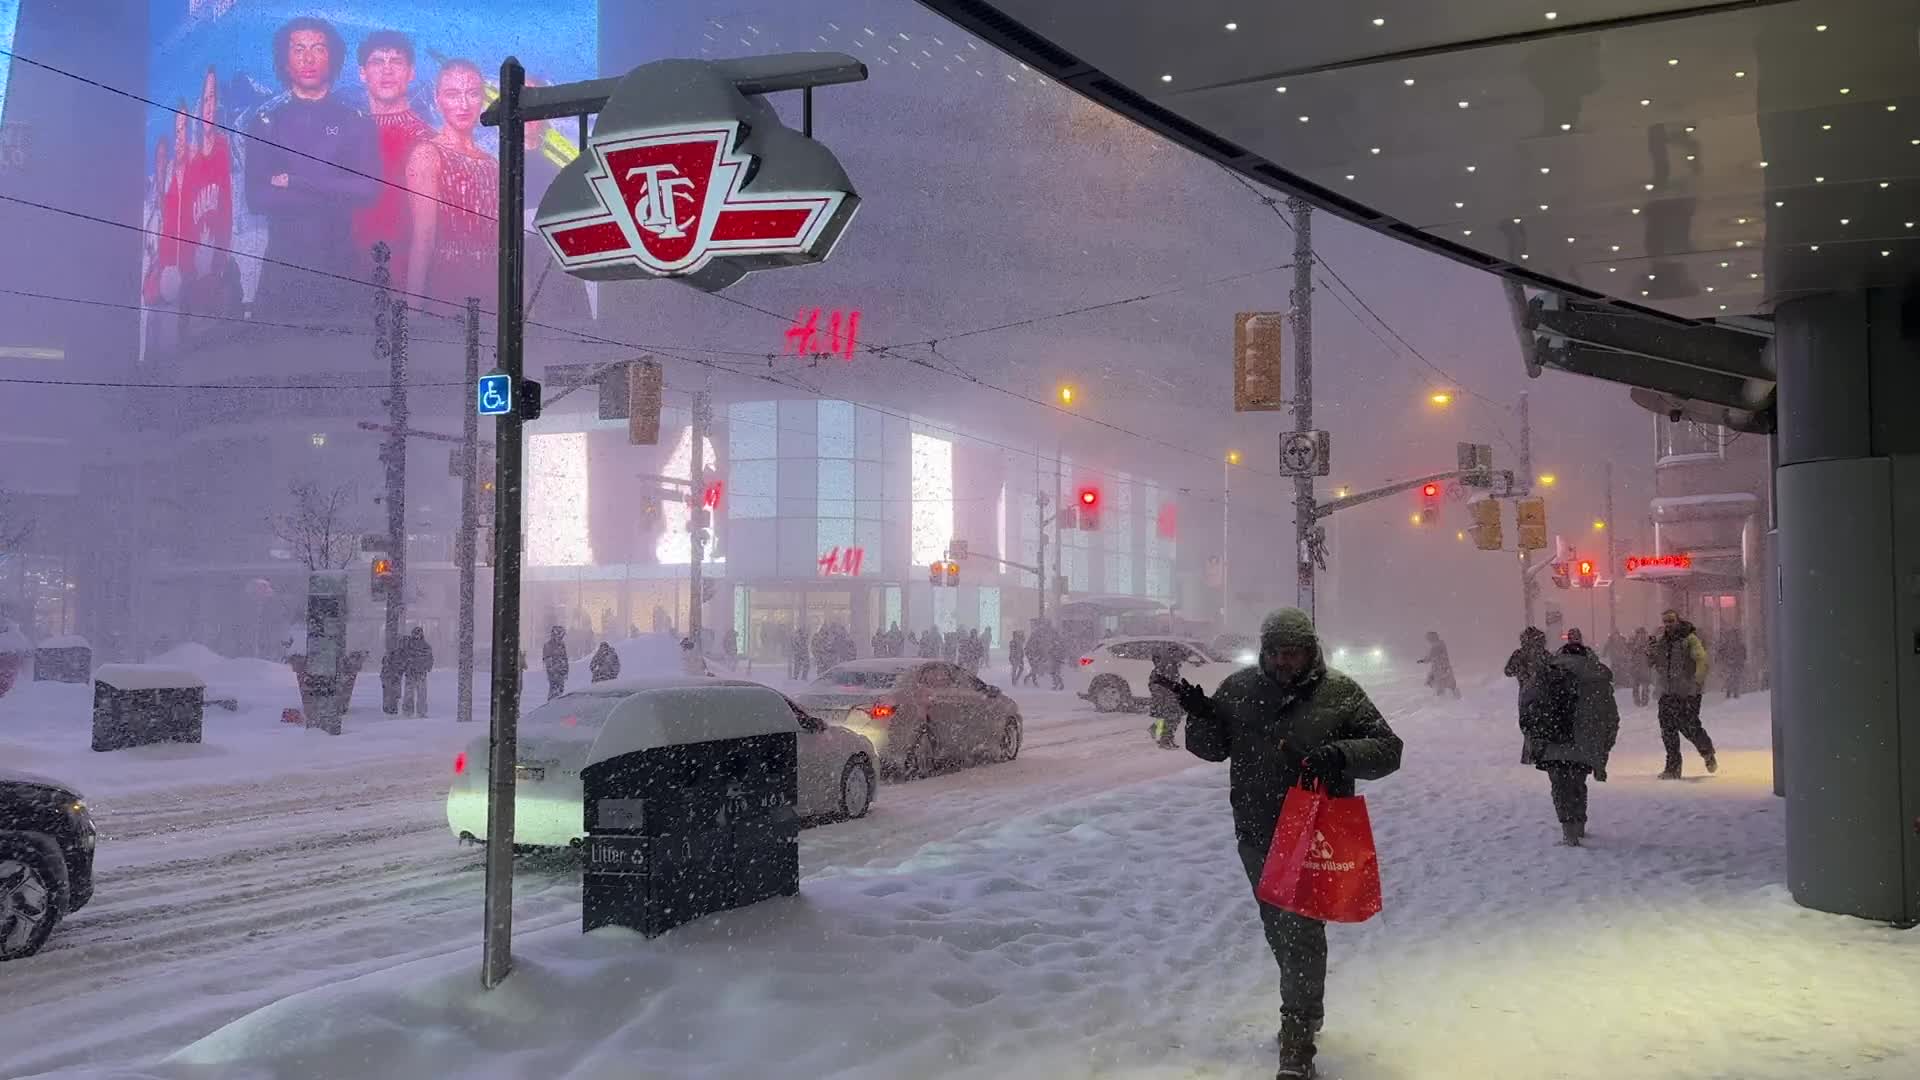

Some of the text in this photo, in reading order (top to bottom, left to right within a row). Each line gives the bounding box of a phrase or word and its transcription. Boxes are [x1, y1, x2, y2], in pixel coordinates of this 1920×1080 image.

[625, 163, 696, 239] TTC
[591, 843, 625, 864] Litter
[1321, 861, 1355, 872] village
